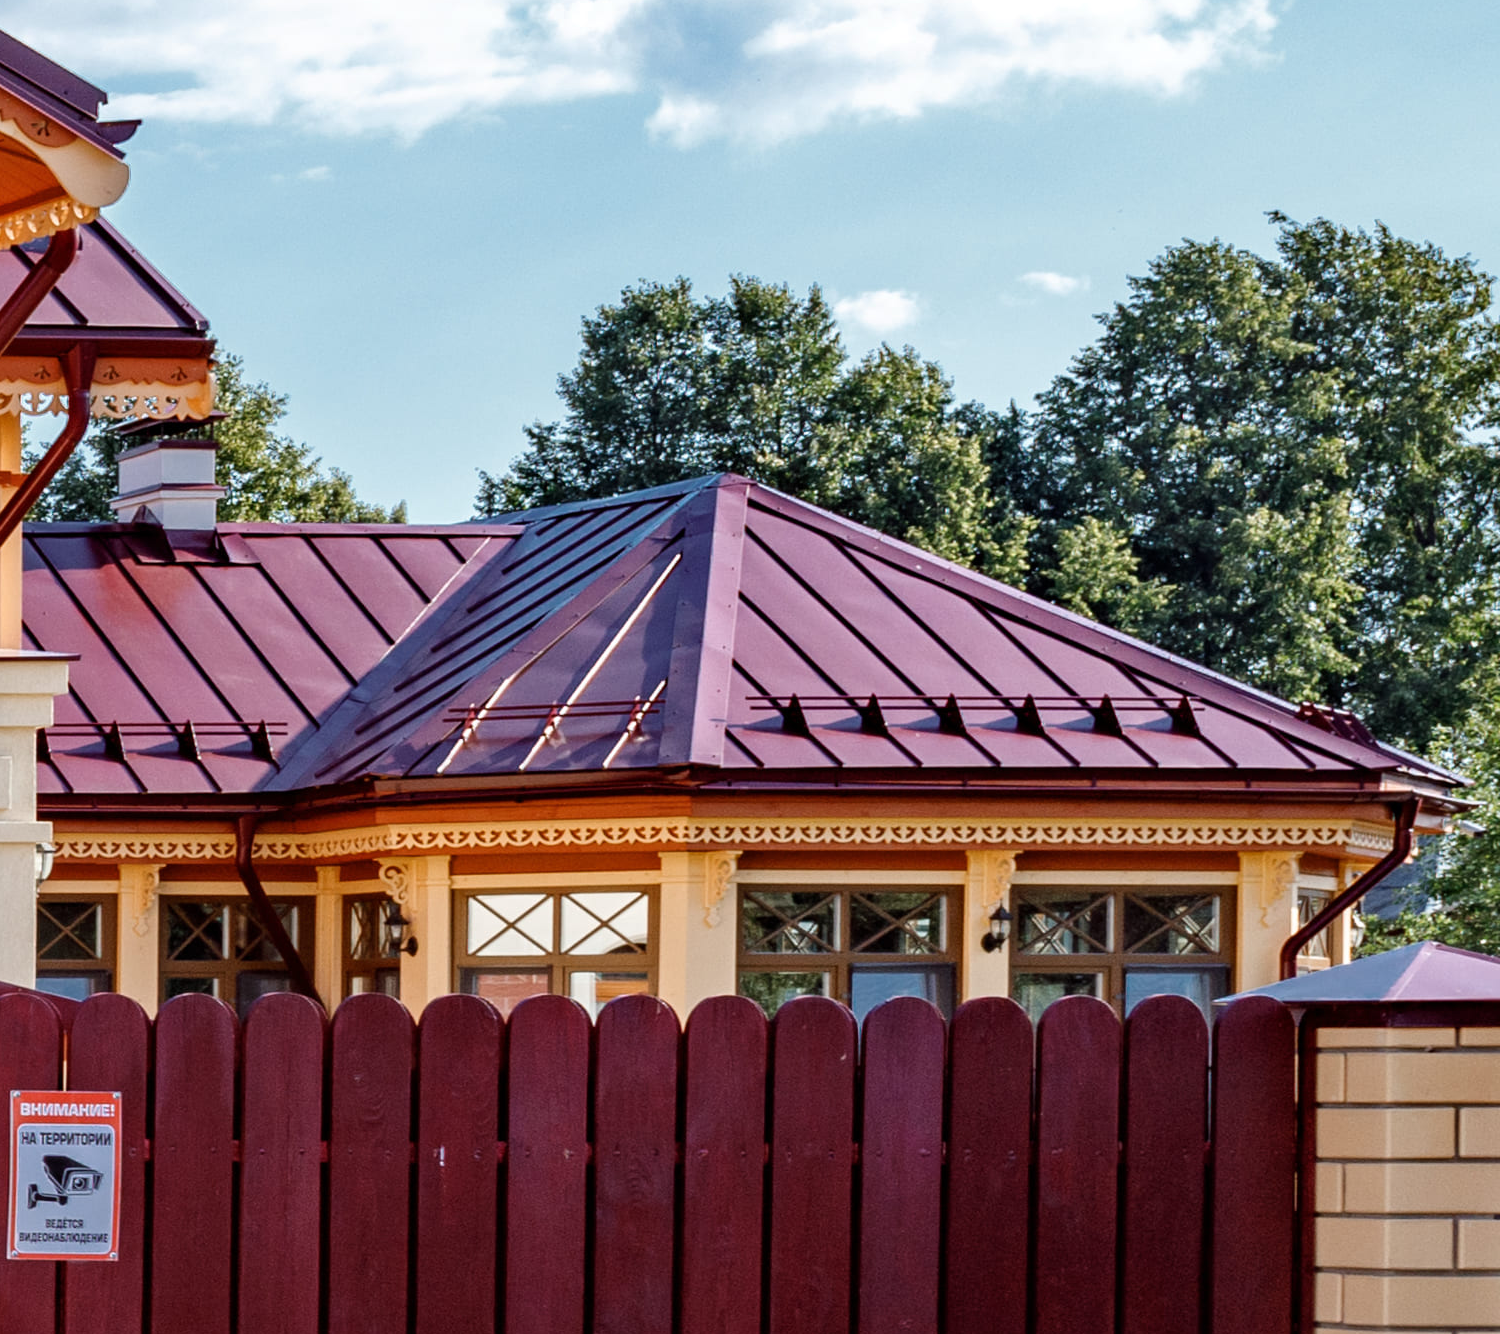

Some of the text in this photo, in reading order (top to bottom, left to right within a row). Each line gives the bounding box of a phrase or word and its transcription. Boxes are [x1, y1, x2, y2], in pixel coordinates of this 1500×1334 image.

[20, 1102, 116, 1117] ВНИМАНИЕ!
[21, 1131, 112, 1146] НА ТЕРРИТОРИИ
[19, 1232, 109, 1244] ВИДЕОНАБЛЮДЕНИЕ
